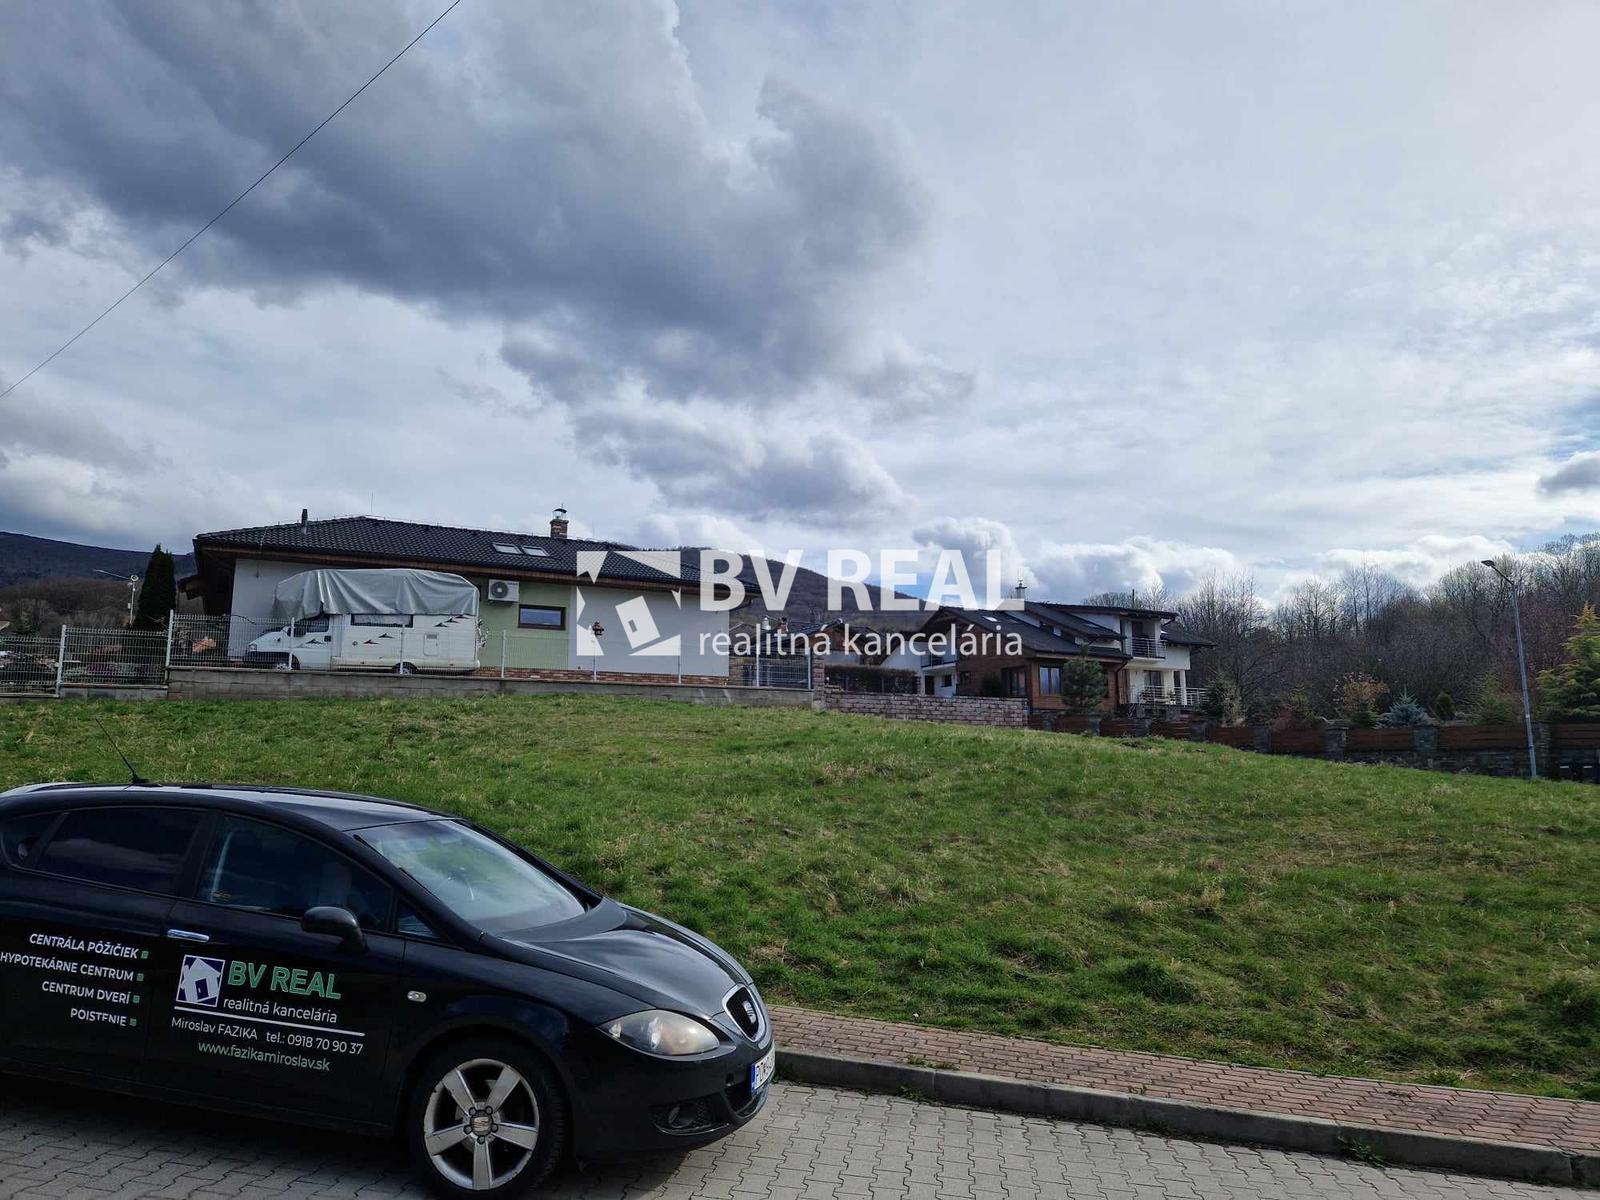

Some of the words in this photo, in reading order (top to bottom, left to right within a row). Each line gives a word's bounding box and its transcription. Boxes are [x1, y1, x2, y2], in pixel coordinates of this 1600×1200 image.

[29, 933, 85, 951] CENTRÁLA
[87, 940, 139, 959] PÔŽIČIEK
[0, 951, 78, 973] HYPOTEKÁRNE
[80, 963, 134, 981] CENTRUM
[227, 960, 267, 989] BV
[270, 966, 341, 1000] REAL
[42, 980, 94, 999] CENTRUM
[96, 989, 131, 1004] DVERÍ
[223, 998, 270, 1014] realitná
[272, 1002, 337, 1023] kancelária
[171, 1016, 216, 1033] Miroslav
[218, 1023, 258, 1041] FAZIKA
[287, 1033, 313, 1048] 0918
[316, 1037, 330, 1050] 70
[332, 1040, 347, 1053] 90
[349, 1042, 364, 1055] 37
[198, 1041, 330, 1071] www.fazikamiroslav.sk
